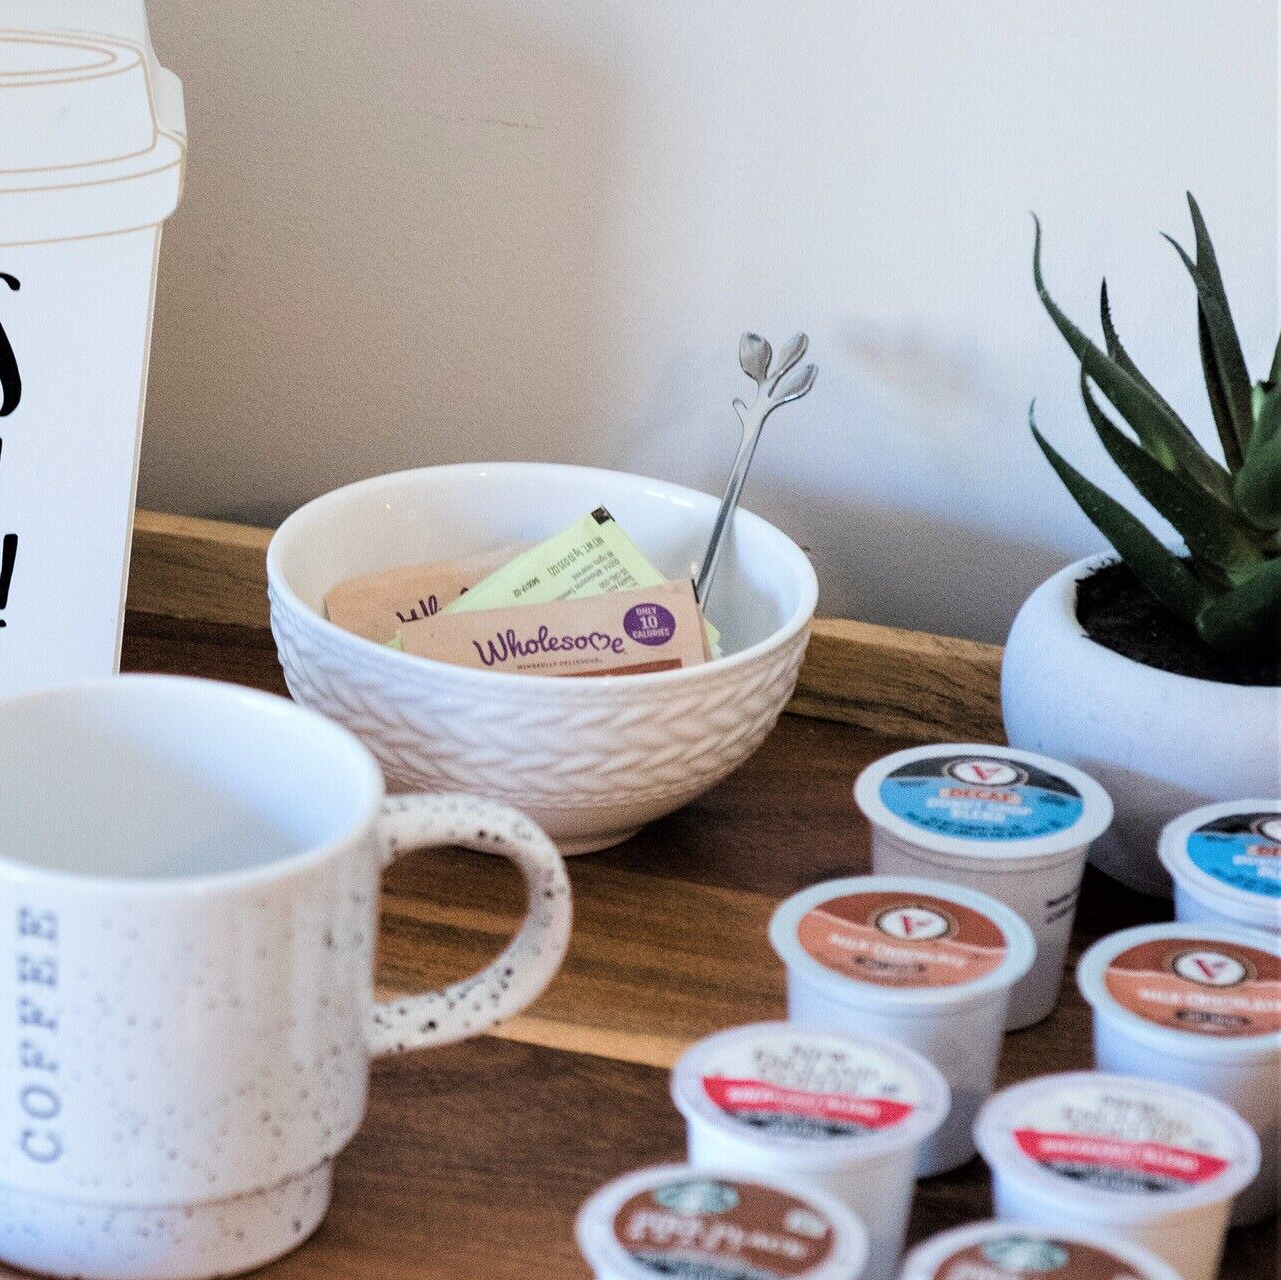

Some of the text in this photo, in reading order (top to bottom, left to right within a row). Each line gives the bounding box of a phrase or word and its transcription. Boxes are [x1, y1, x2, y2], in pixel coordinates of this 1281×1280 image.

[635, 605, 657, 616] ONLY
[640, 616, 659, 630] 10
[632, 628, 670, 639] CALORIES
[17, 905, 63, 1164] COFFEE
